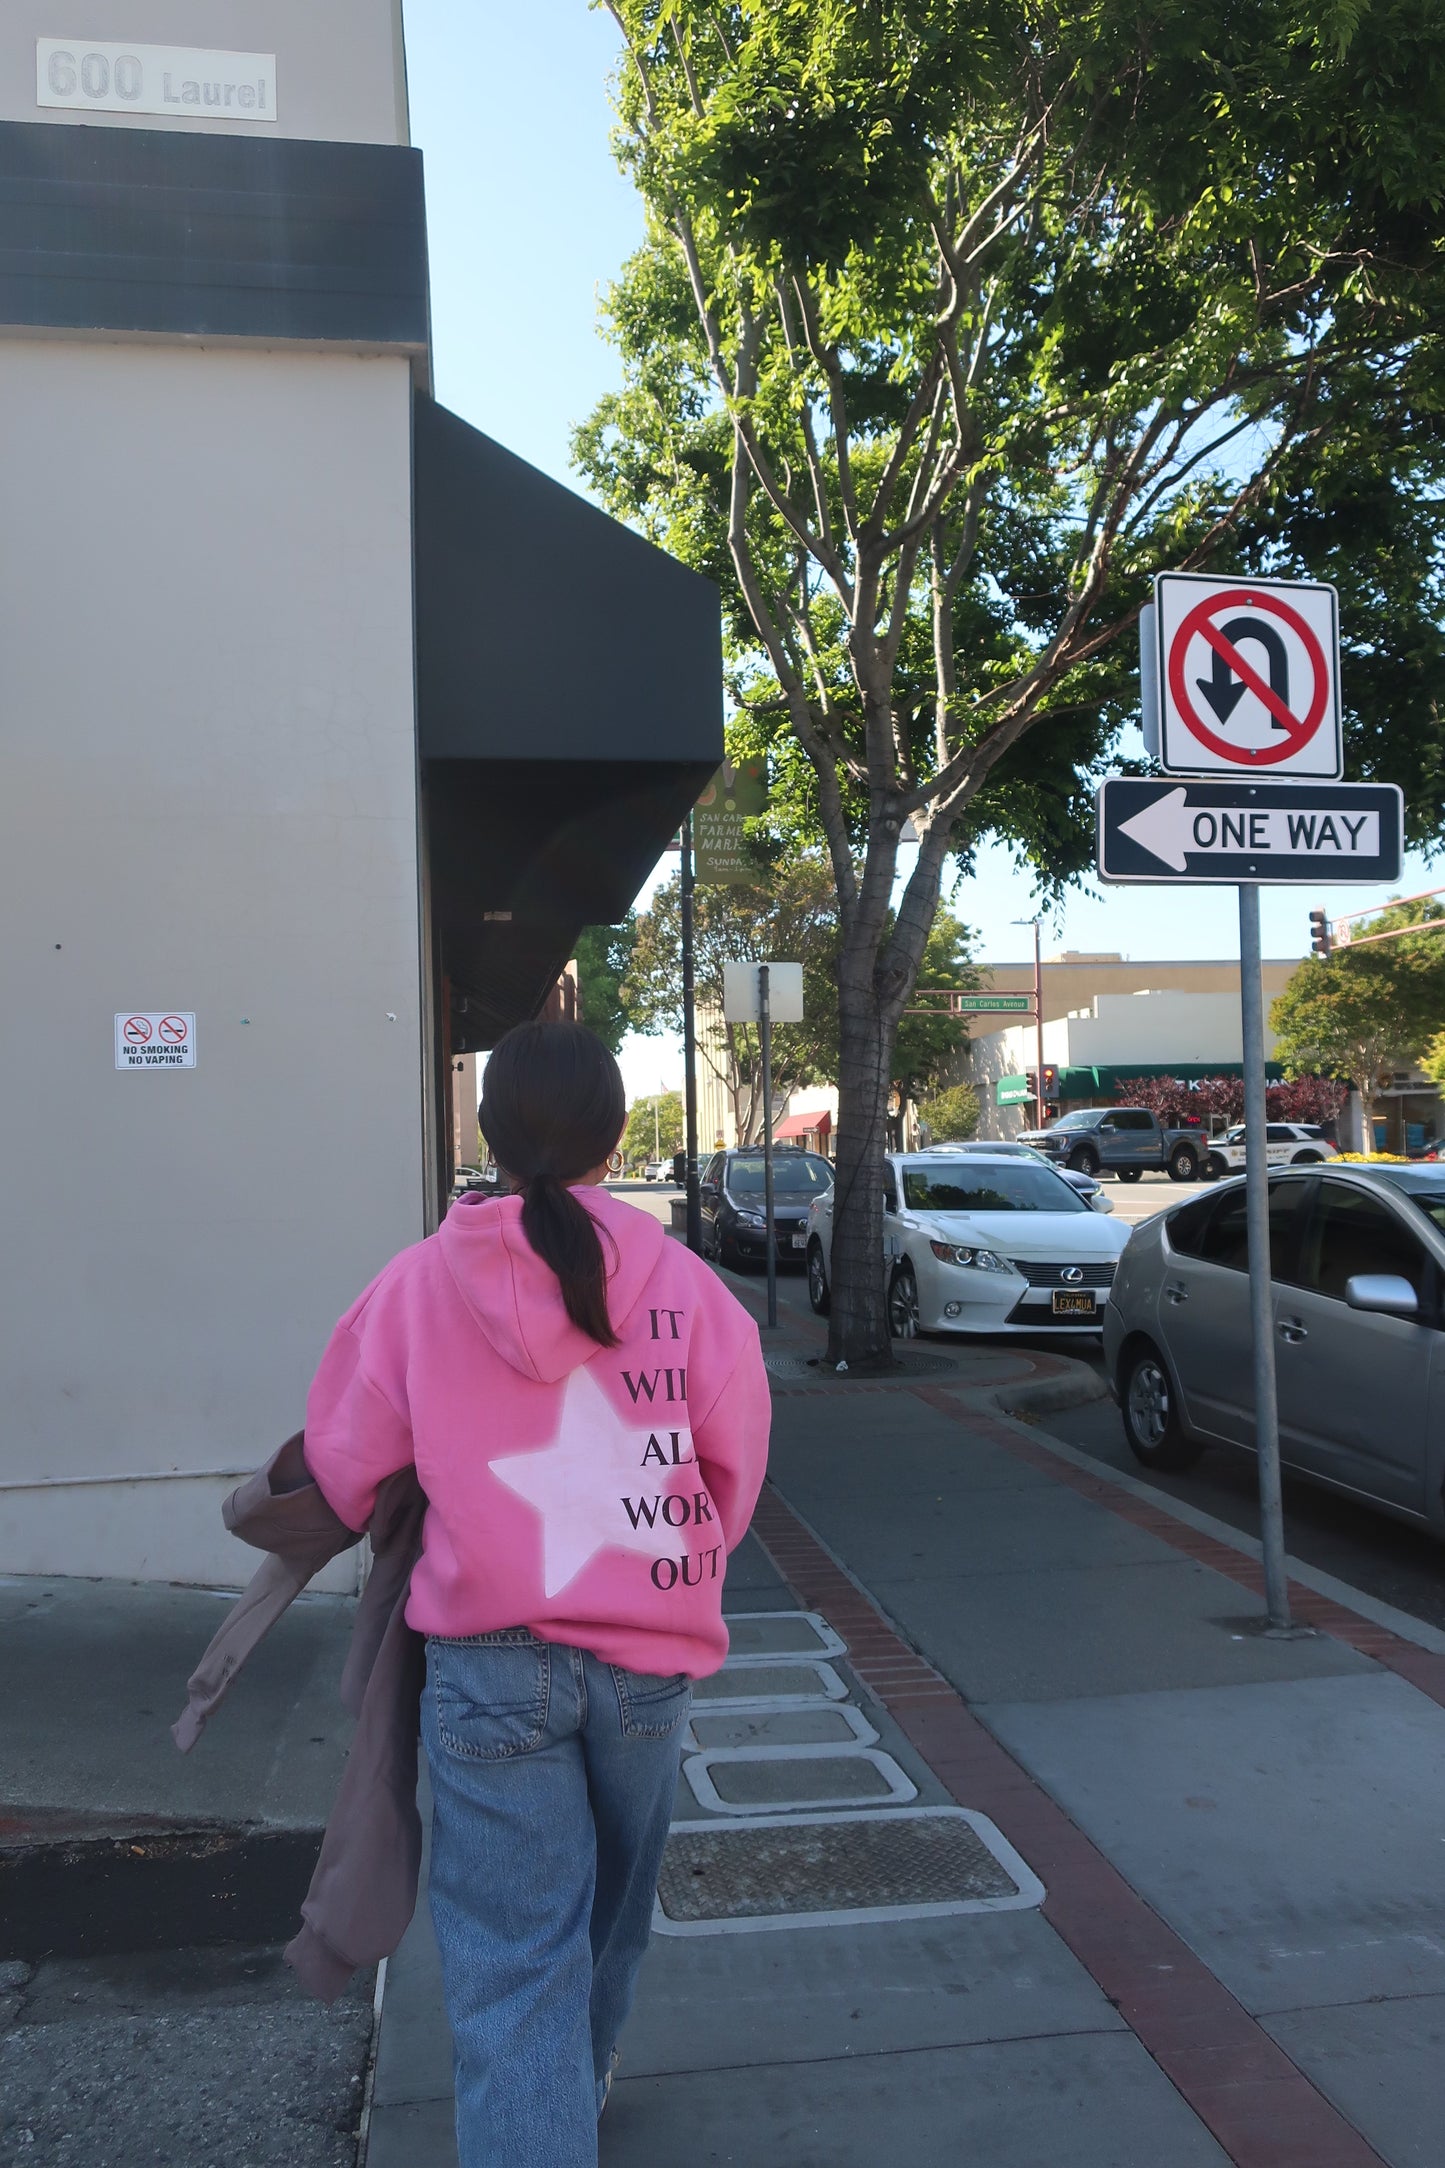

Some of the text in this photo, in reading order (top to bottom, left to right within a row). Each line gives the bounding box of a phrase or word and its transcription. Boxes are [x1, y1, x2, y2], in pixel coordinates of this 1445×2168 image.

[48, 50, 266, 109] 600 Laurel
[700, 813, 742, 822] SAN CAR
[700, 825, 742, 836] FARME
[1193, 812, 1368, 850] ONE WAY
[701, 838, 744, 850] MARK
[964, 1000, 1025, 1008] San Carlos Avenue
[123, 1045, 188, 1054] NO SMOKING
[129, 1055, 183, 1064] NO VAPING
[648, 1308, 684, 1340] IT
[620, 1368, 688, 1404] WIL
[640, 1432, 700, 1467] AL
[620, 1491, 714, 1531] WOR
[651, 1545, 722, 1591] OUT
